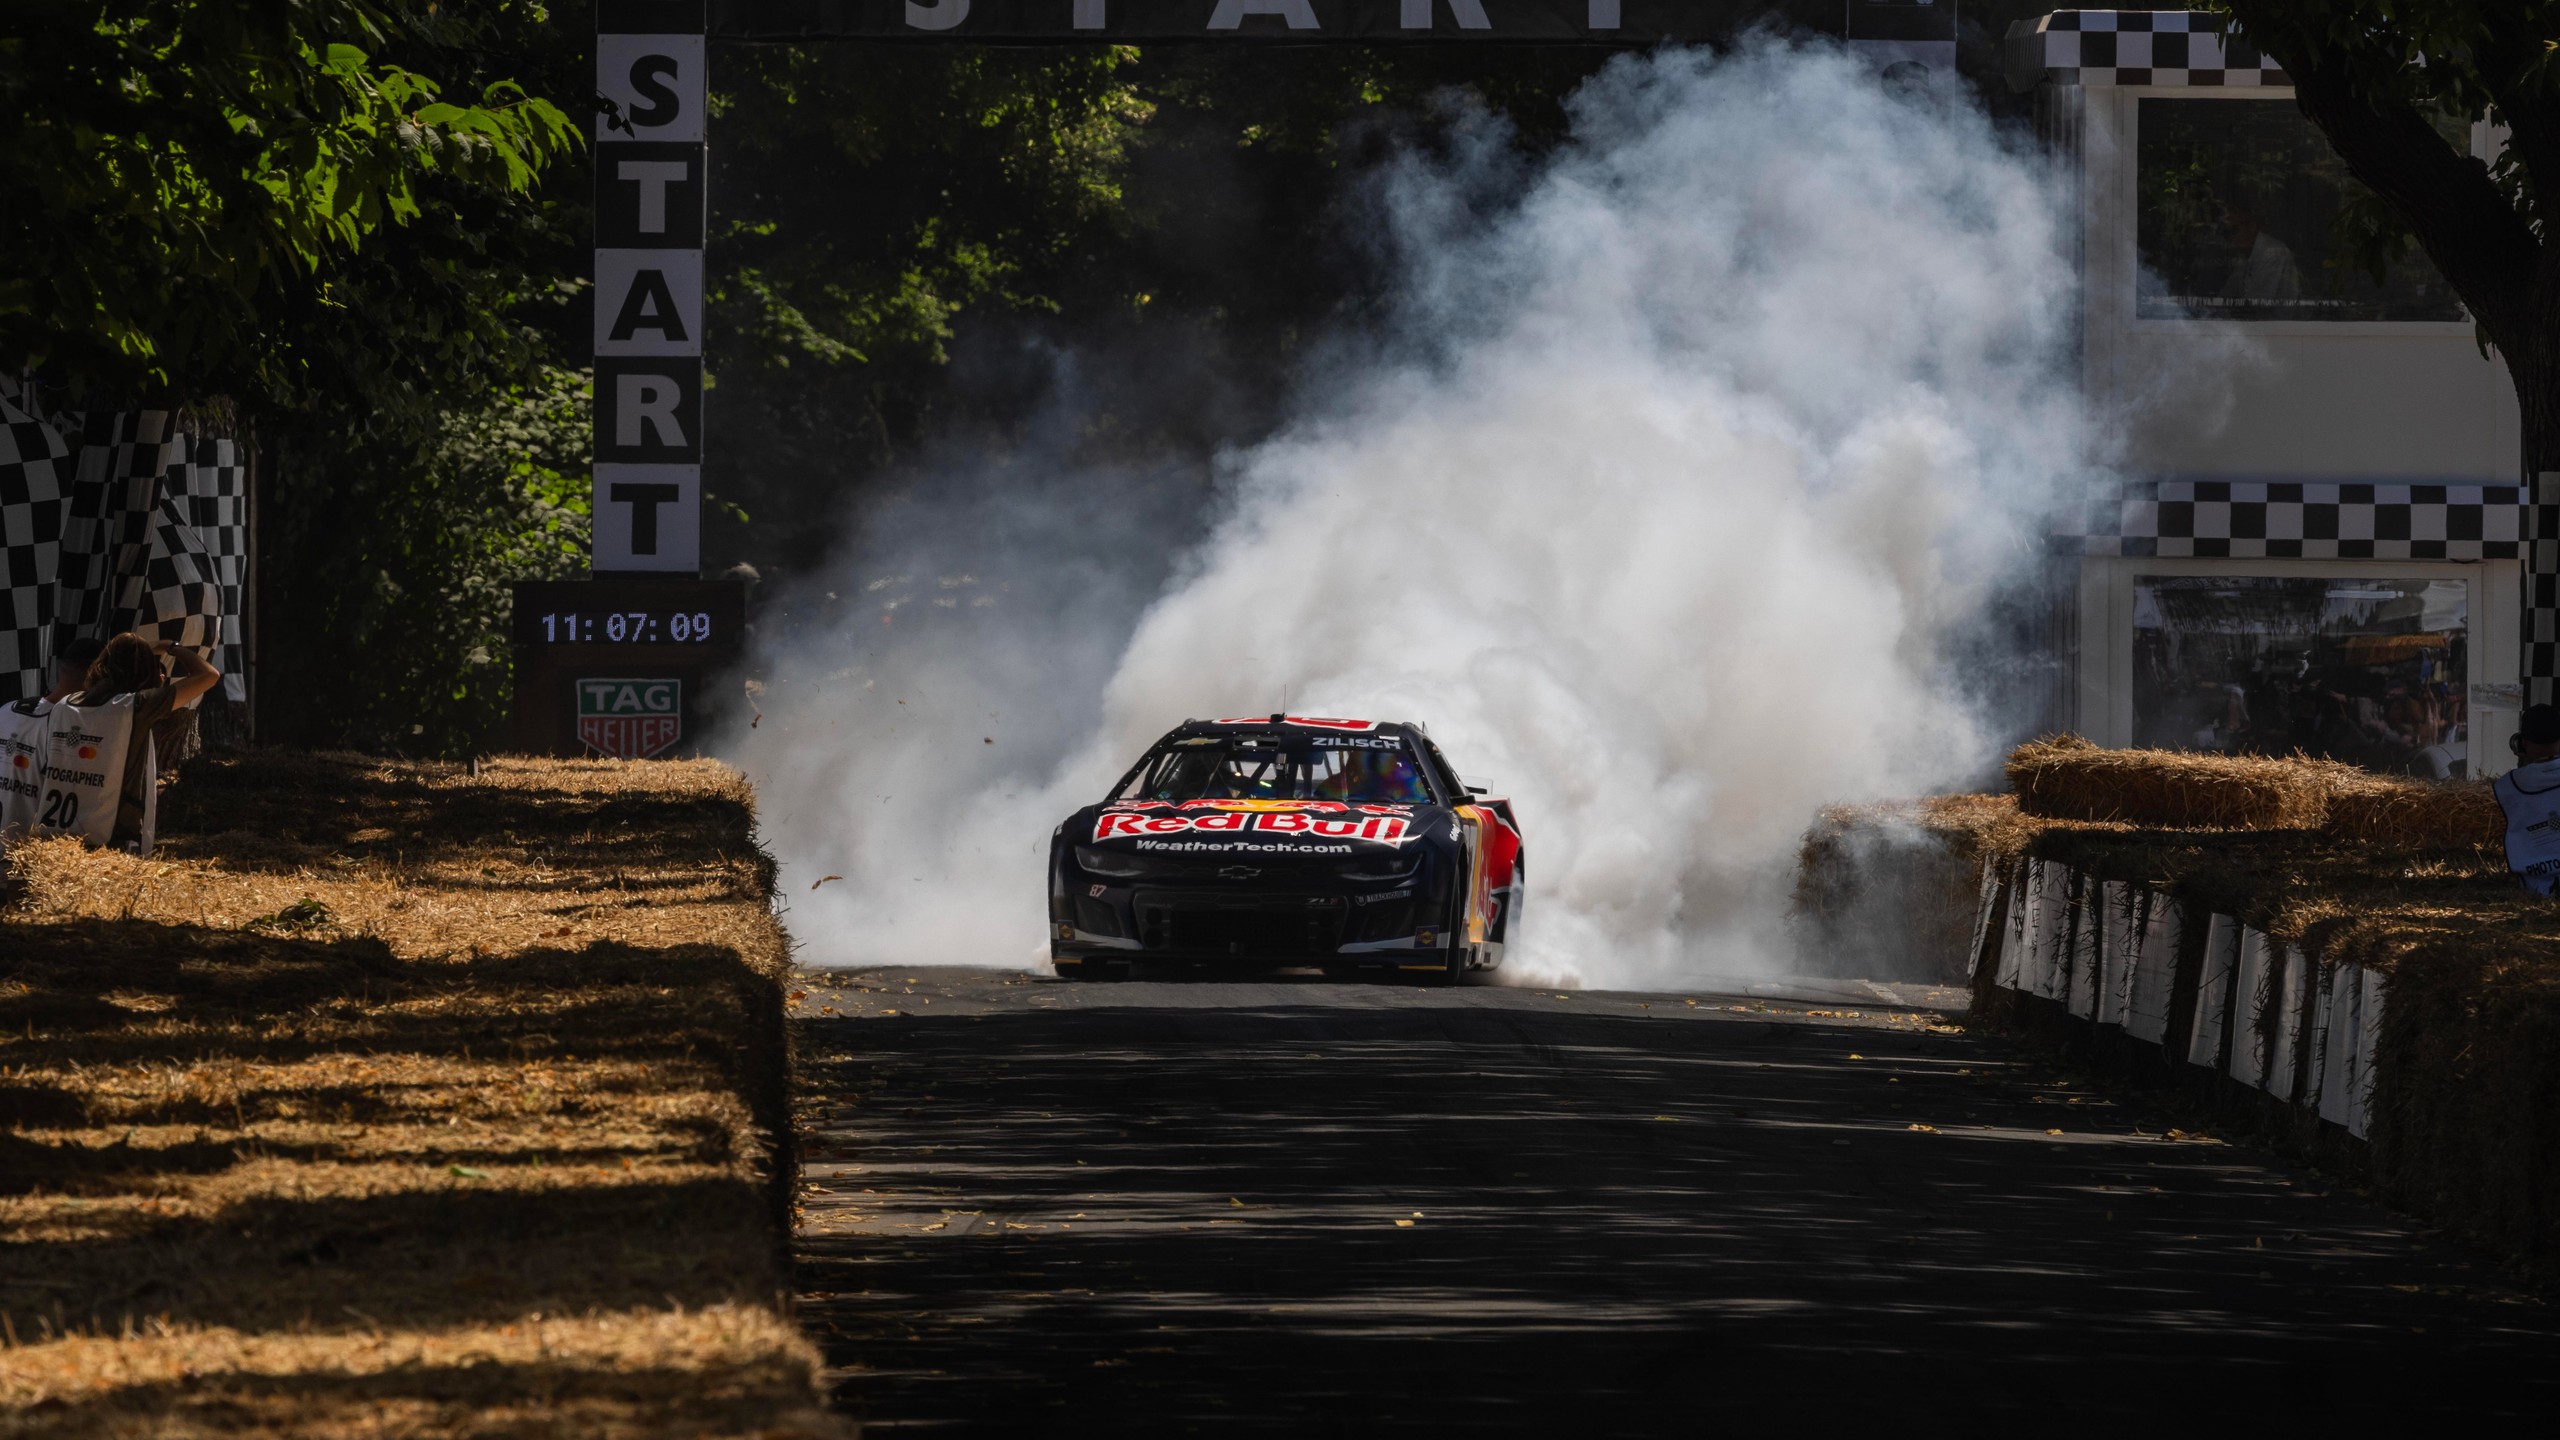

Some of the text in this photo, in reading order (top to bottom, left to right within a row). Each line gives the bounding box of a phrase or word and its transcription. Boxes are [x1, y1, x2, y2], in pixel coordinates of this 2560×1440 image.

[607, 54, 688, 556] START
[584, 684, 672, 713] TAG
[583, 718, 675, 759] HEUER
[1312, 736, 1401, 750] ZILISCH
[41, 766, 105, 788] TOGRAPHER
[40, 788, 79, 829] 20
[1094, 812, 1249, 842] Red
[1252, 812, 1410, 848] Bull
[1089, 884, 1108, 898] 87
